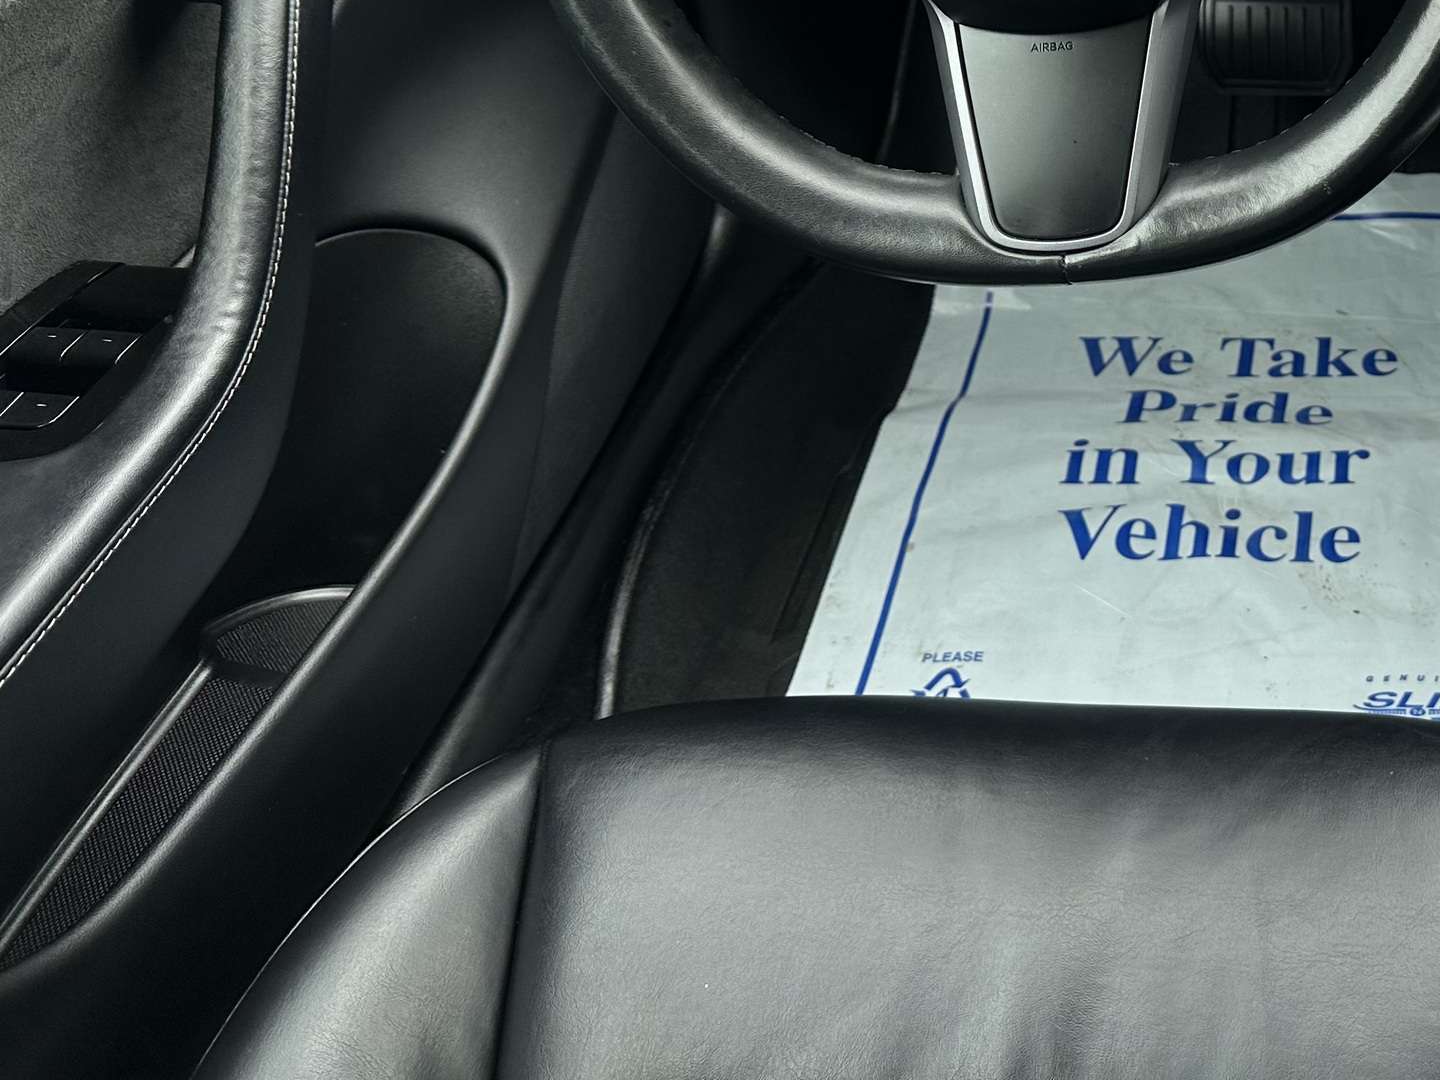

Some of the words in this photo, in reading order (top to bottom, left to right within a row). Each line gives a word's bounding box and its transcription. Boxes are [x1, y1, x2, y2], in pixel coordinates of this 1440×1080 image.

[1031, 41, 1073, 52] AIRBAG
[1081, 336, 1194, 377] We
[1221, 336, 1399, 378] Take
[1122, 389, 1334, 424] Pride
[1060, 439, 1139, 484] in
[1170, 439, 1370, 484] Your
[1058, 503, 1362, 563] Vehicle
[922, 650, 984, 662] PLEASE
